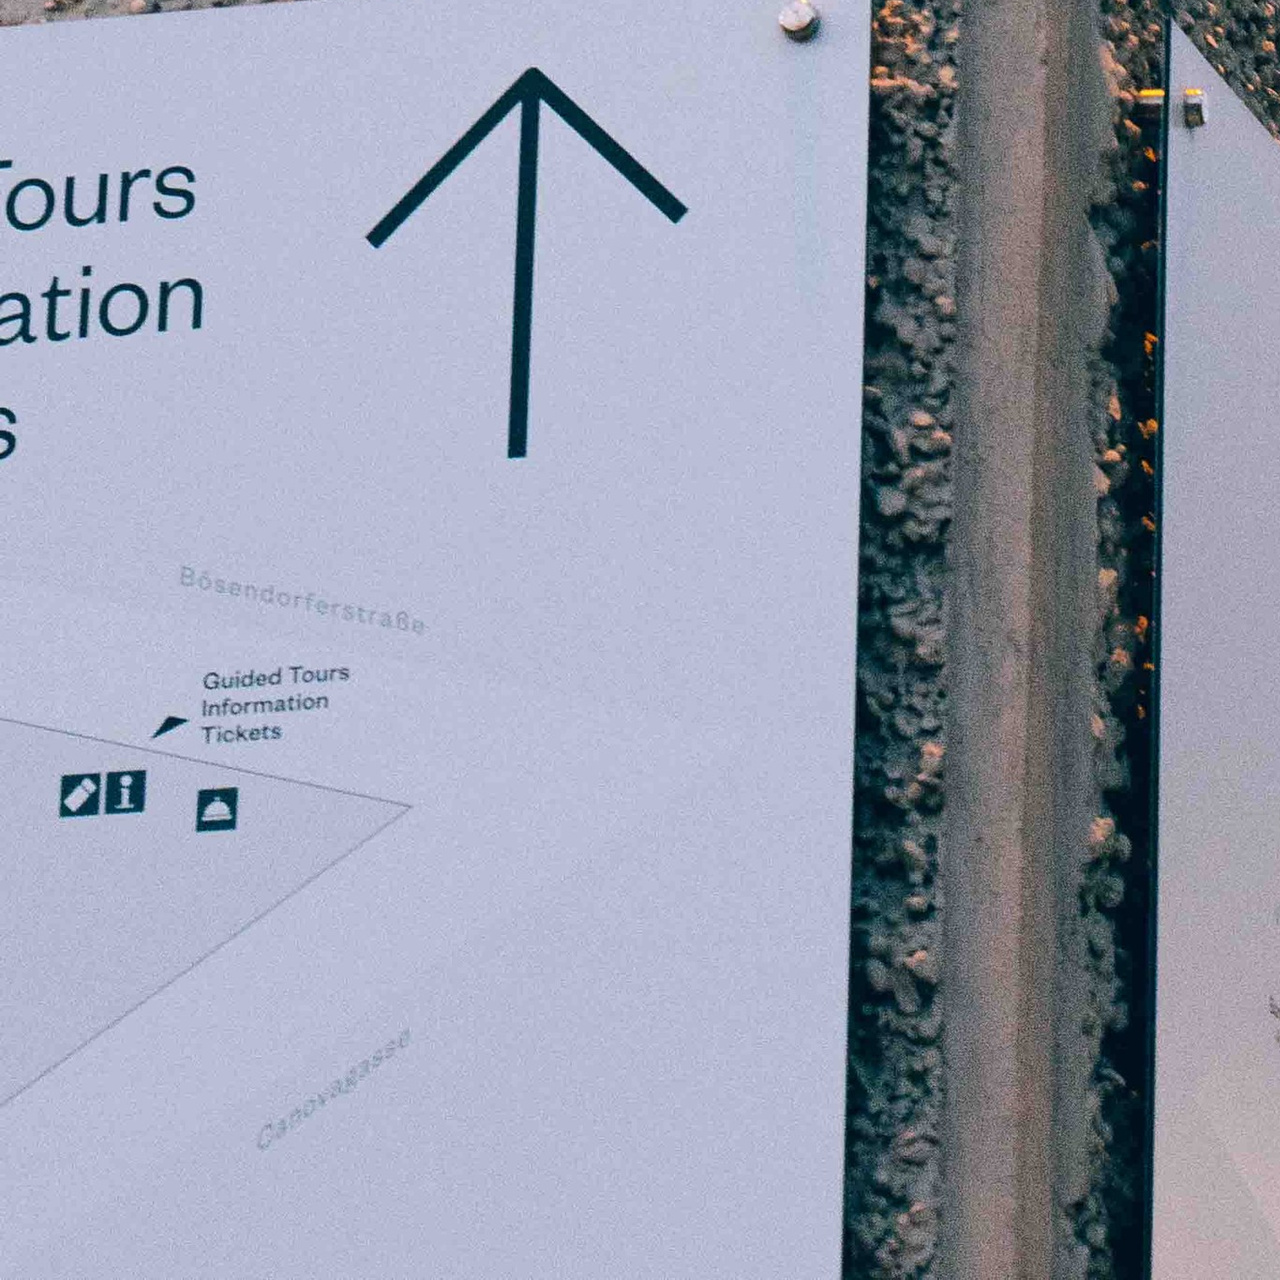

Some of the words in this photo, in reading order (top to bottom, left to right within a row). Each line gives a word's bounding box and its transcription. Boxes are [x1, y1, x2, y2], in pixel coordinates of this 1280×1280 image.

[203, 666, 282, 691] Guided
[289, 663, 350, 684] Tours
[201, 693, 329, 718] Information
[203, 723, 282, 745] Tickets
